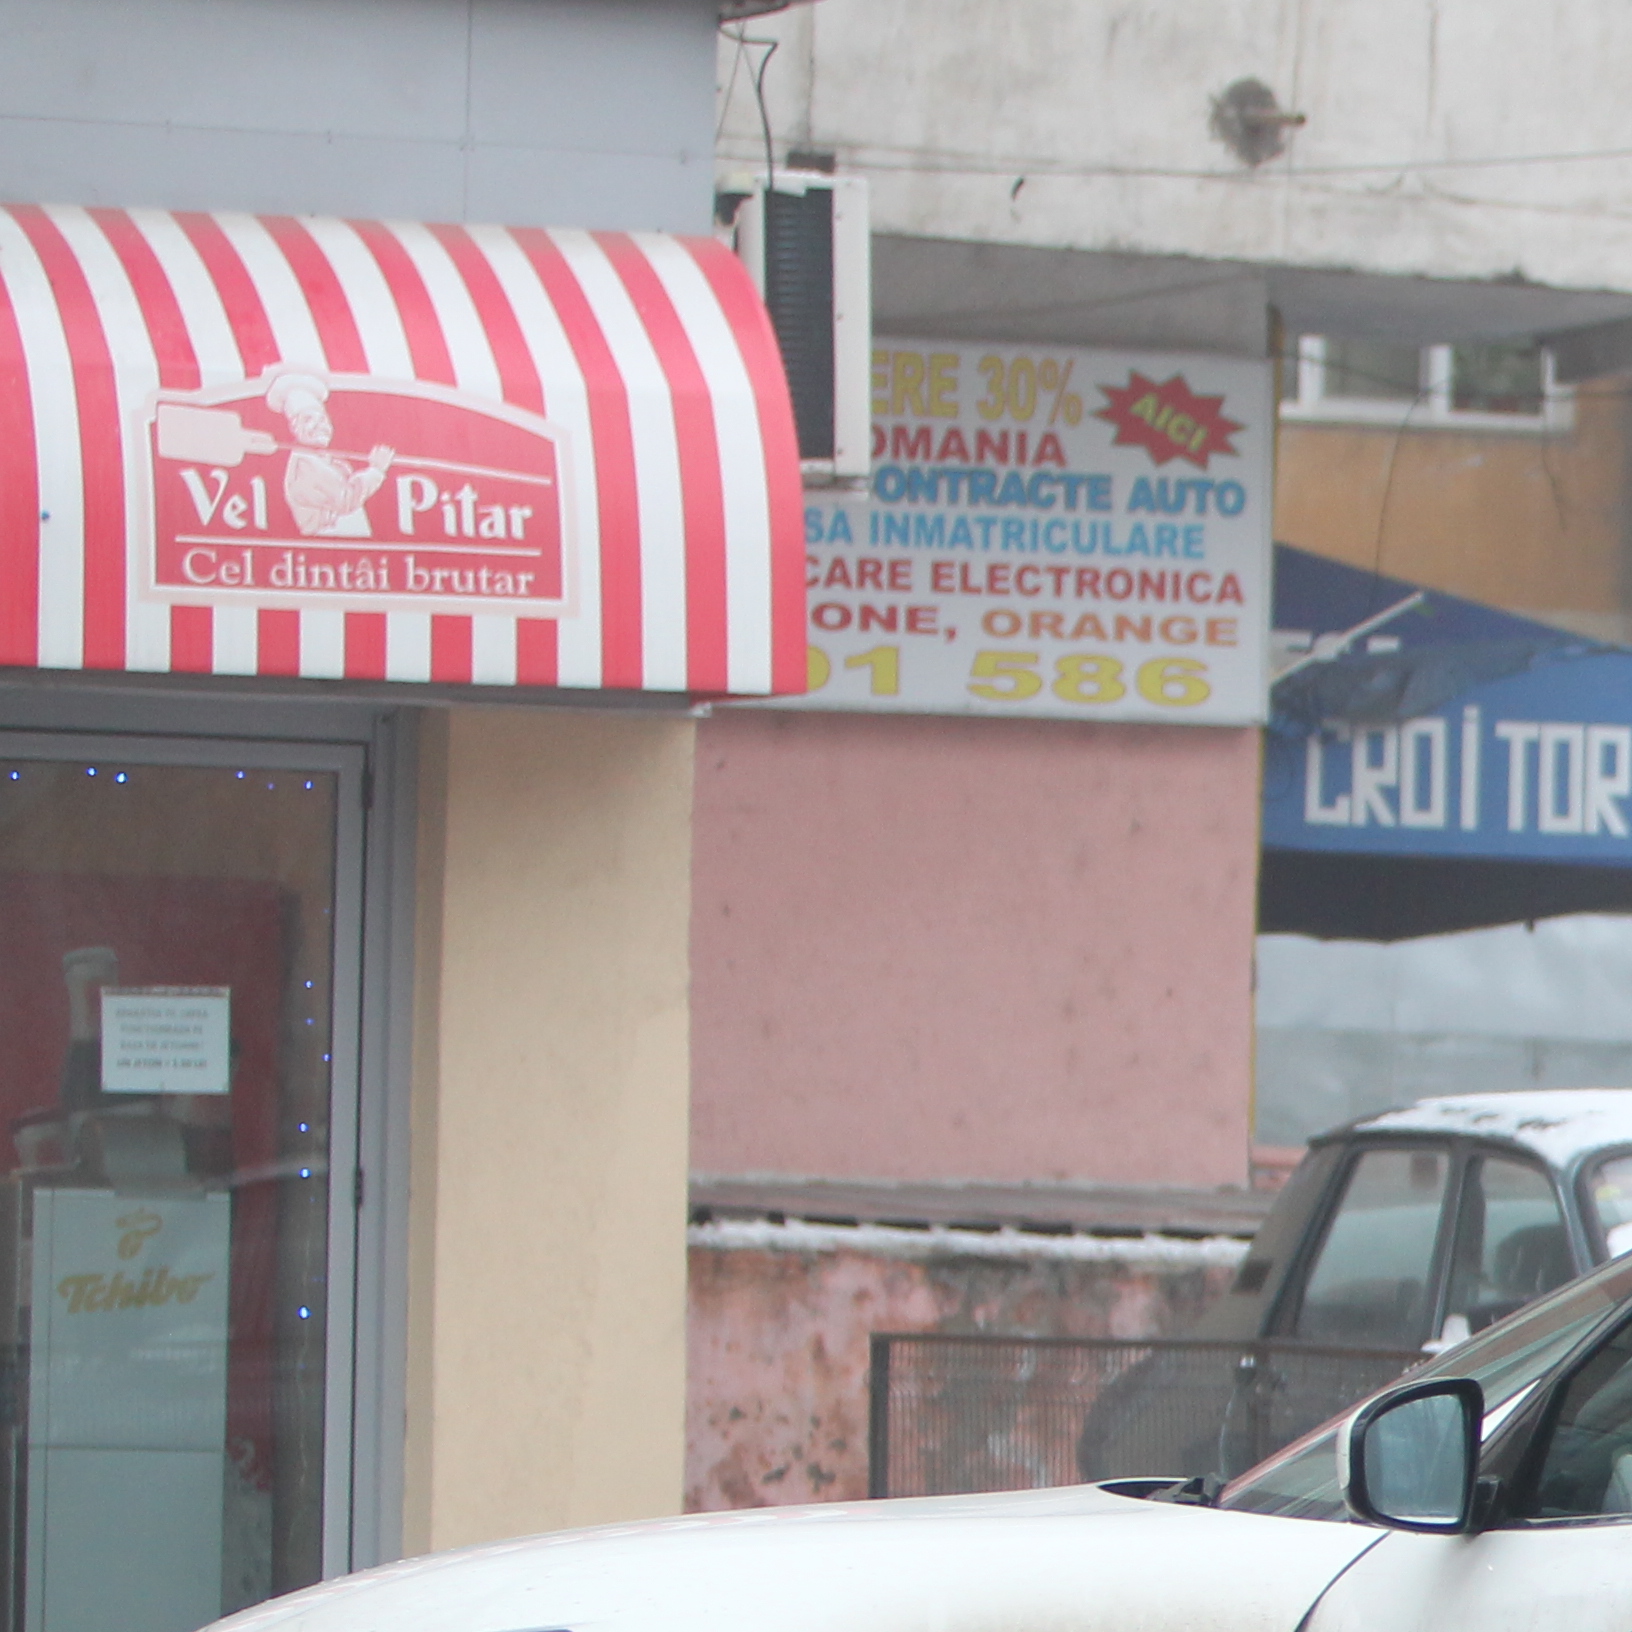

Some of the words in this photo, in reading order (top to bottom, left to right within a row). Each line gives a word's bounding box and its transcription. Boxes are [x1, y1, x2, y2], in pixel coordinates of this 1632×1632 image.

[976, 355, 1083, 427] 30%
[1129, 393, 1208, 452] AICI
[179, 467, 268, 532] Vel
[395, 474, 534, 541] Pitar
[1127, 475, 1246, 518] AUTO
[869, 510, 1205, 560] INMATRICULARE
[181, 546, 255, 587] Cel
[269, 549, 392, 590] dintâi
[405, 554, 536, 597] brutar
[930, 560, 1246, 604] ELECTRONICA
[981, 608, 1239, 647] ORANGE
[966, 650, 1212, 708] 586
[56, 1265, 216, 1315] Tchibo
